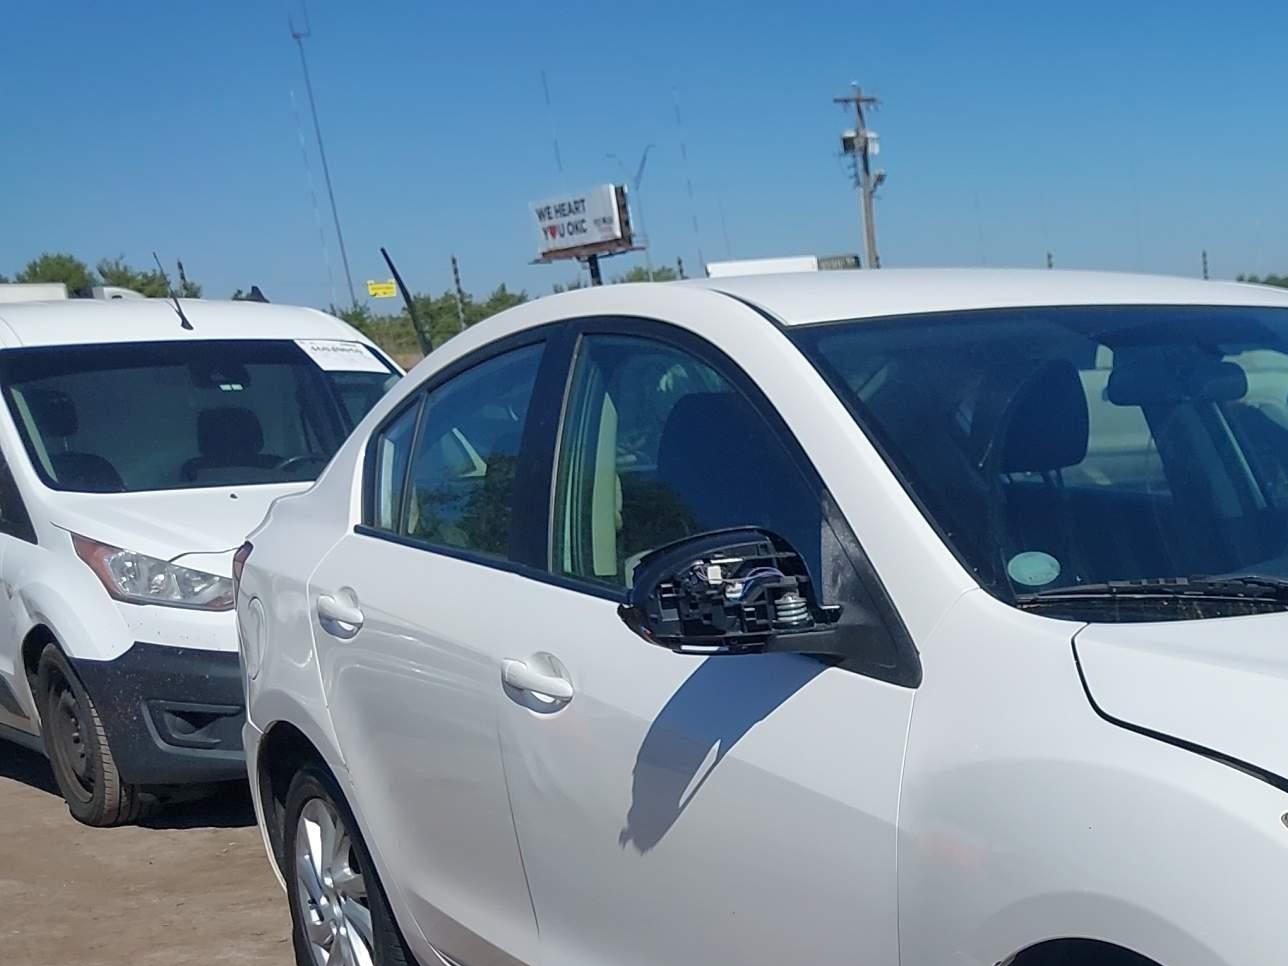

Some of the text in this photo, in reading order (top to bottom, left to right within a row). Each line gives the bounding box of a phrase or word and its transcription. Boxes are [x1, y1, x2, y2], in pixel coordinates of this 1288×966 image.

[536, 198, 586, 221] WE HEART
[567, 218, 588, 236] OKC
